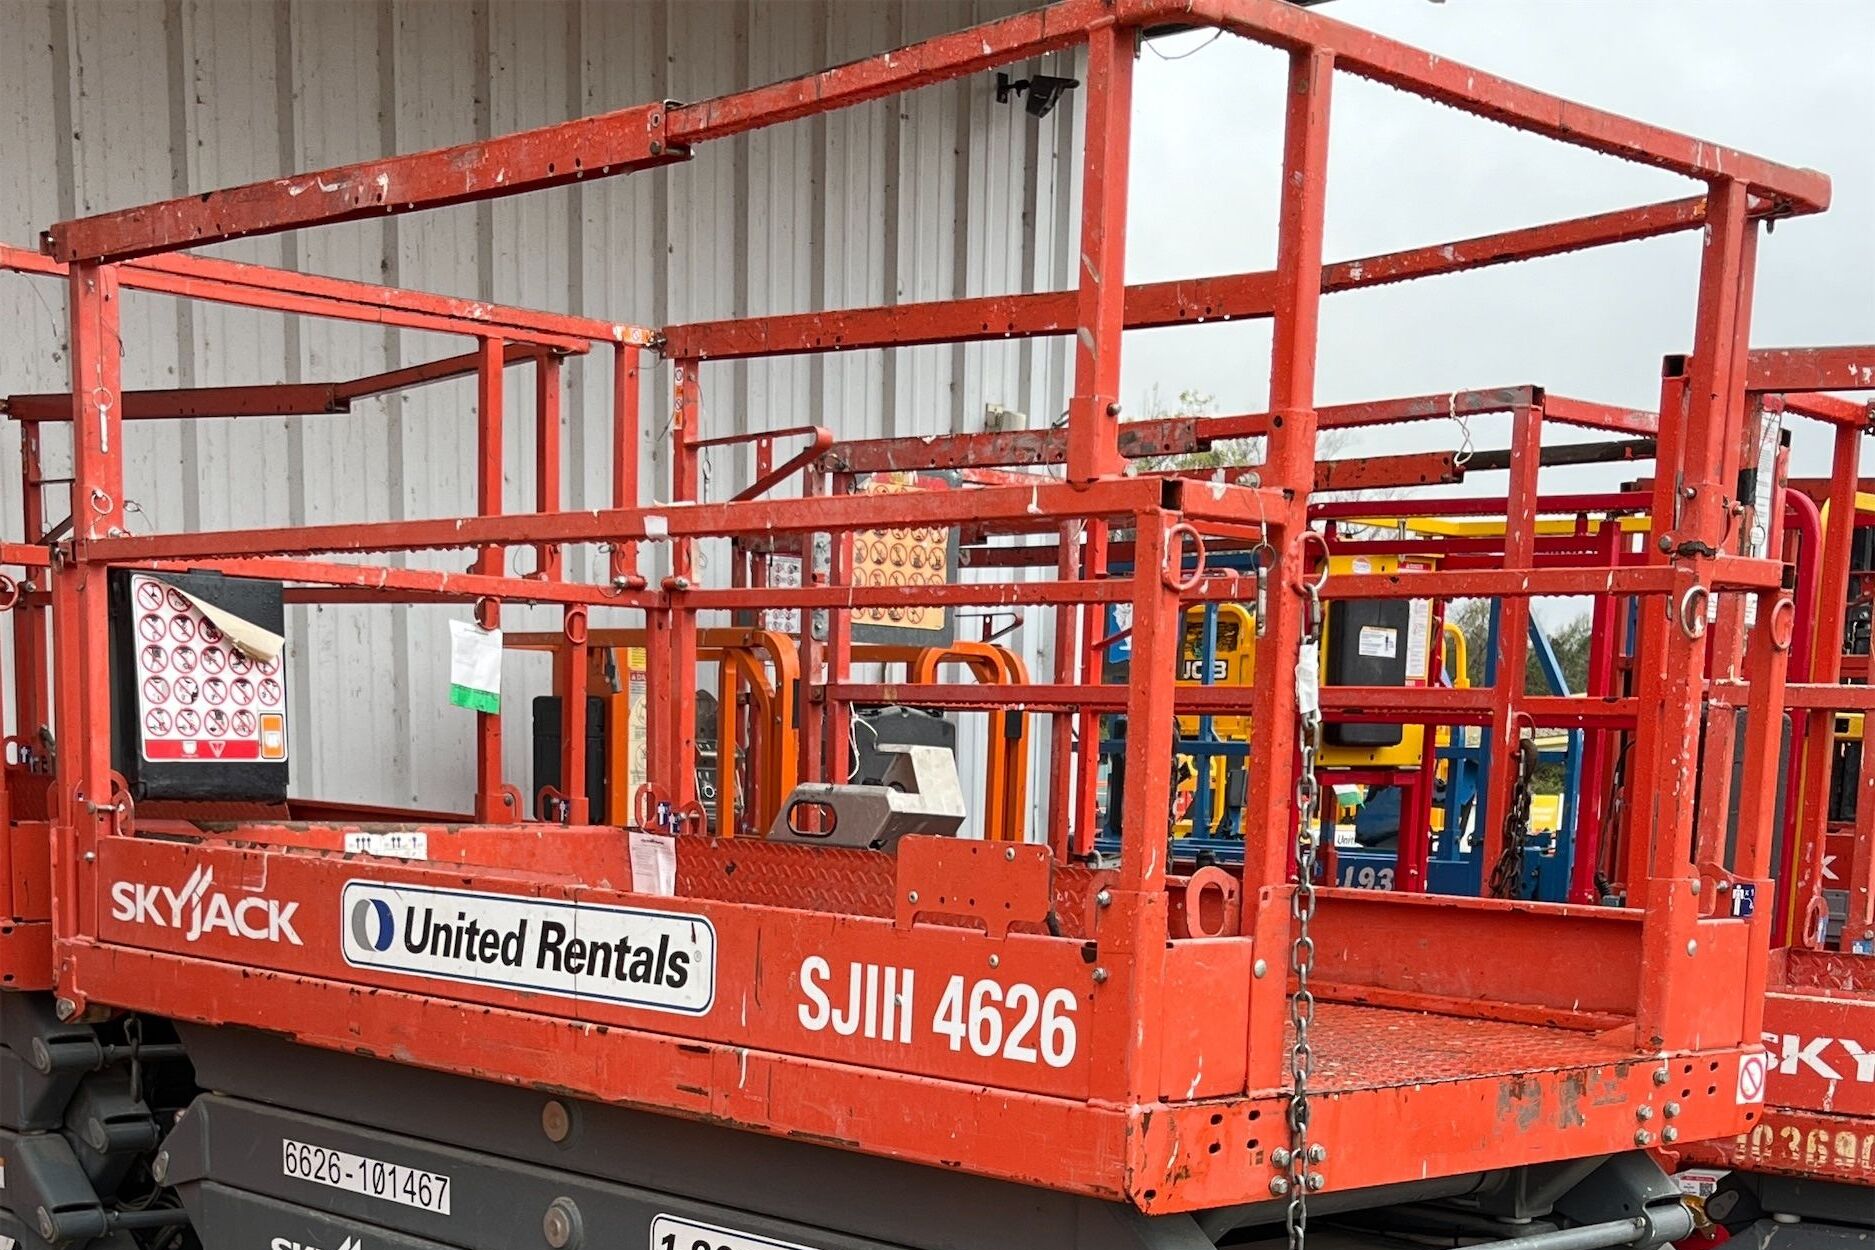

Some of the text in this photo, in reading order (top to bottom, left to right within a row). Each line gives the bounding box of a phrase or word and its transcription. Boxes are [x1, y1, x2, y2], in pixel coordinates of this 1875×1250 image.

[111, 863, 304, 946] SKYJACK
[404, 906, 690, 989] United Rentals
[932, 974, 1078, 1068] 4626
[286, 1142, 448, 1210] 6626-101467
